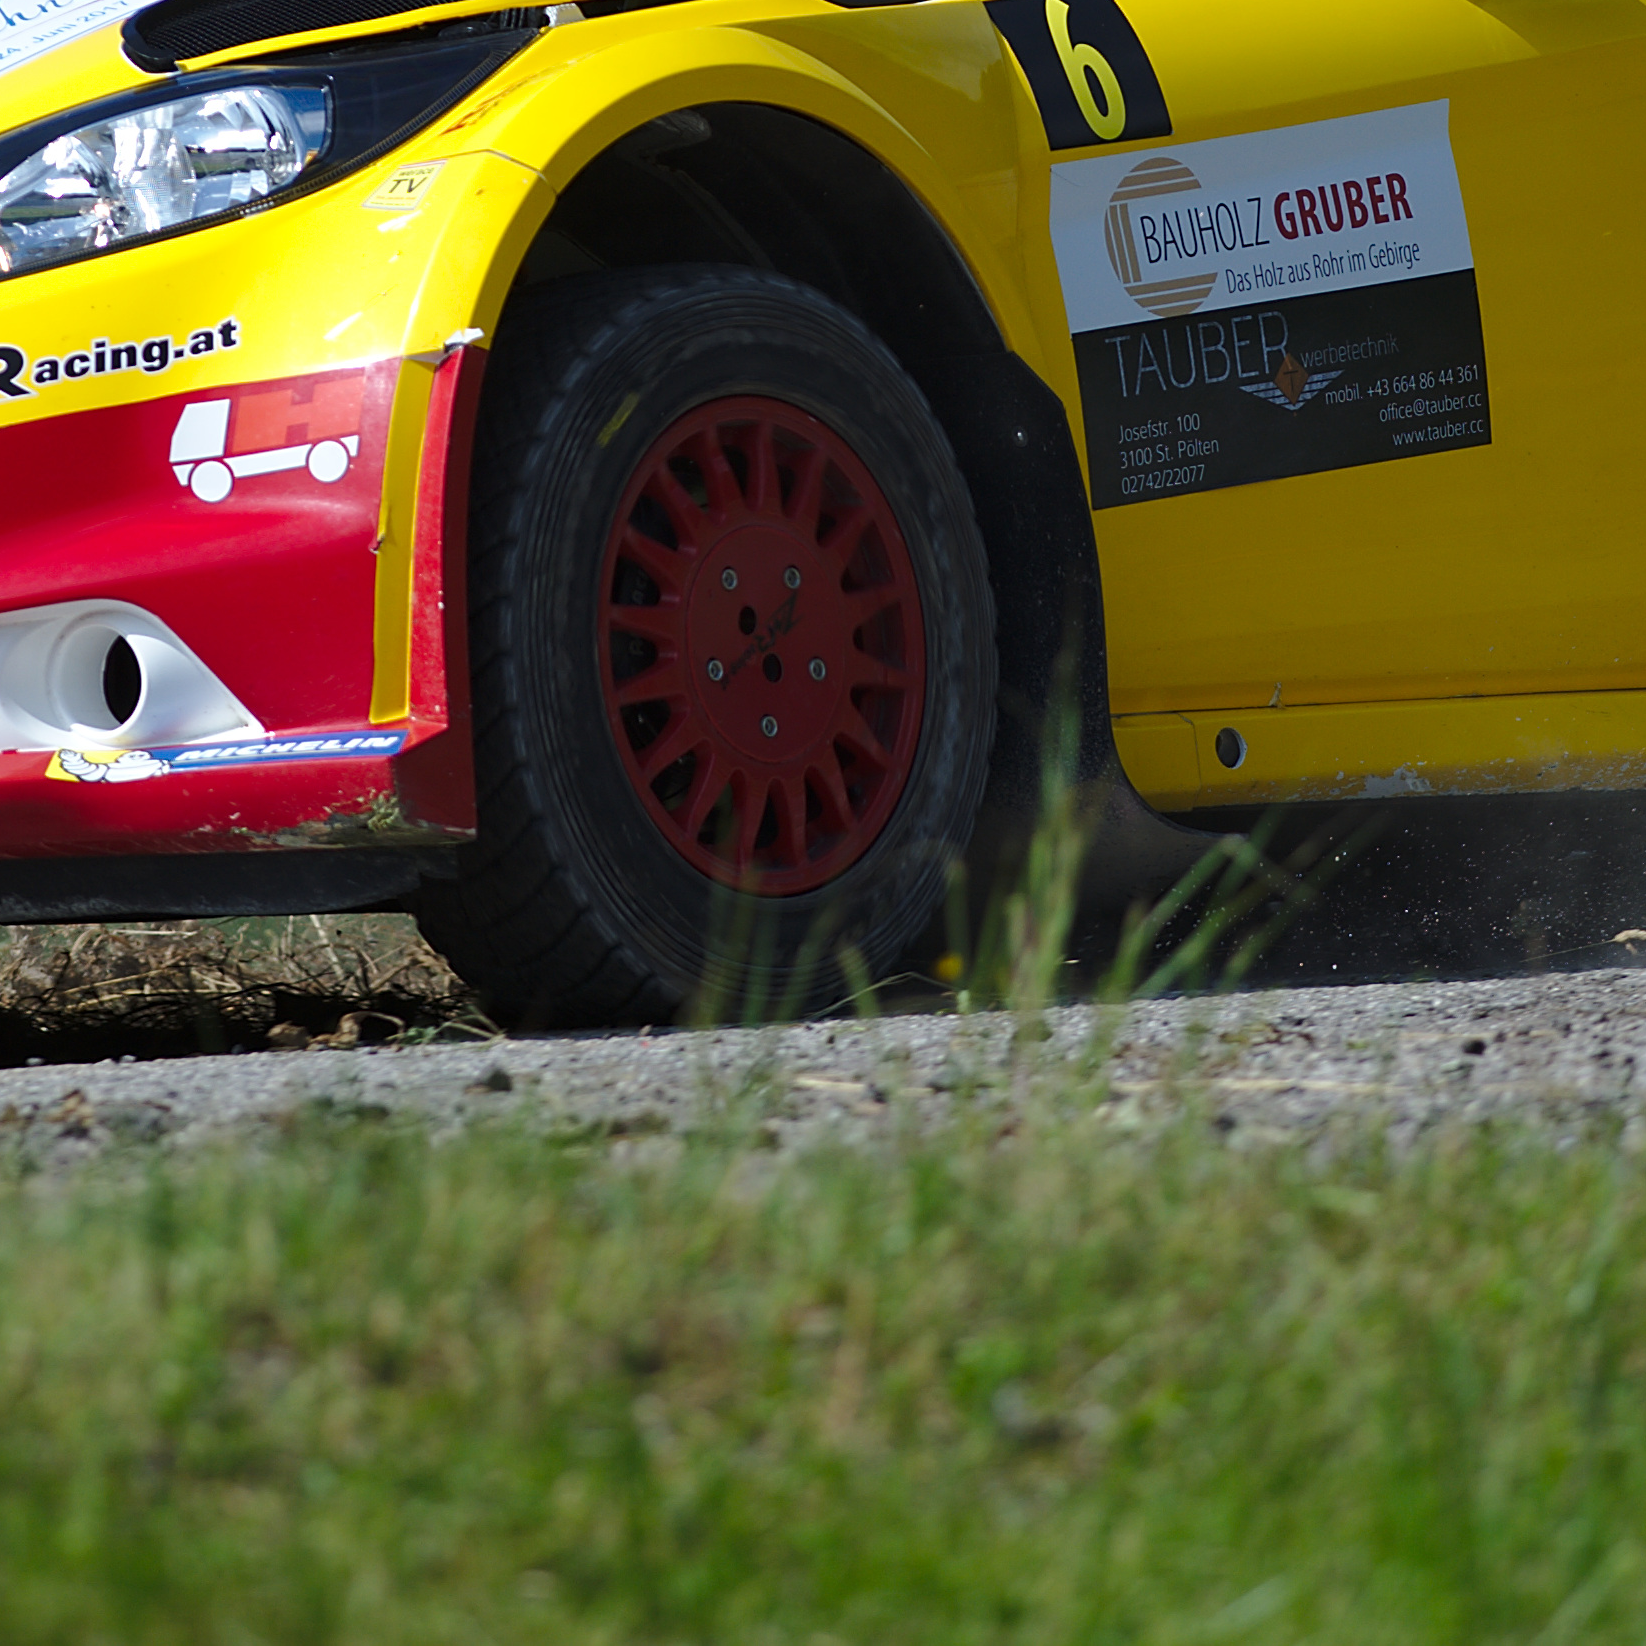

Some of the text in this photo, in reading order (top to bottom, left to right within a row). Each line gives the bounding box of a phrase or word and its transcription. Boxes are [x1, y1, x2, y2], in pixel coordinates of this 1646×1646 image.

[77, 0, 131, 24] 2017
[1139, 172, 1414, 264] BAUHOLZ GRUBER
[1225, 241, 1420, 294] Das Holz aus Rohr im Gebirge
[1105, 310, 1289, 398] TAUBER
[1299, 332, 1401, 368] werbetechnik
[1325, 364, 1479, 405] mobil. +43 664 86 44 361
[1379, 392, 1482, 422] office@tauber.cc
[1119, 412, 1202, 445] Josefstr. 100
[1392, 418, 1485, 446] www.tauber.cc
[1120, 438, 1220, 469] 3100 St. Pölten
[1121, 463, 1206, 495] 02742/22077
[174, 735, 400, 761] MICHELIN
